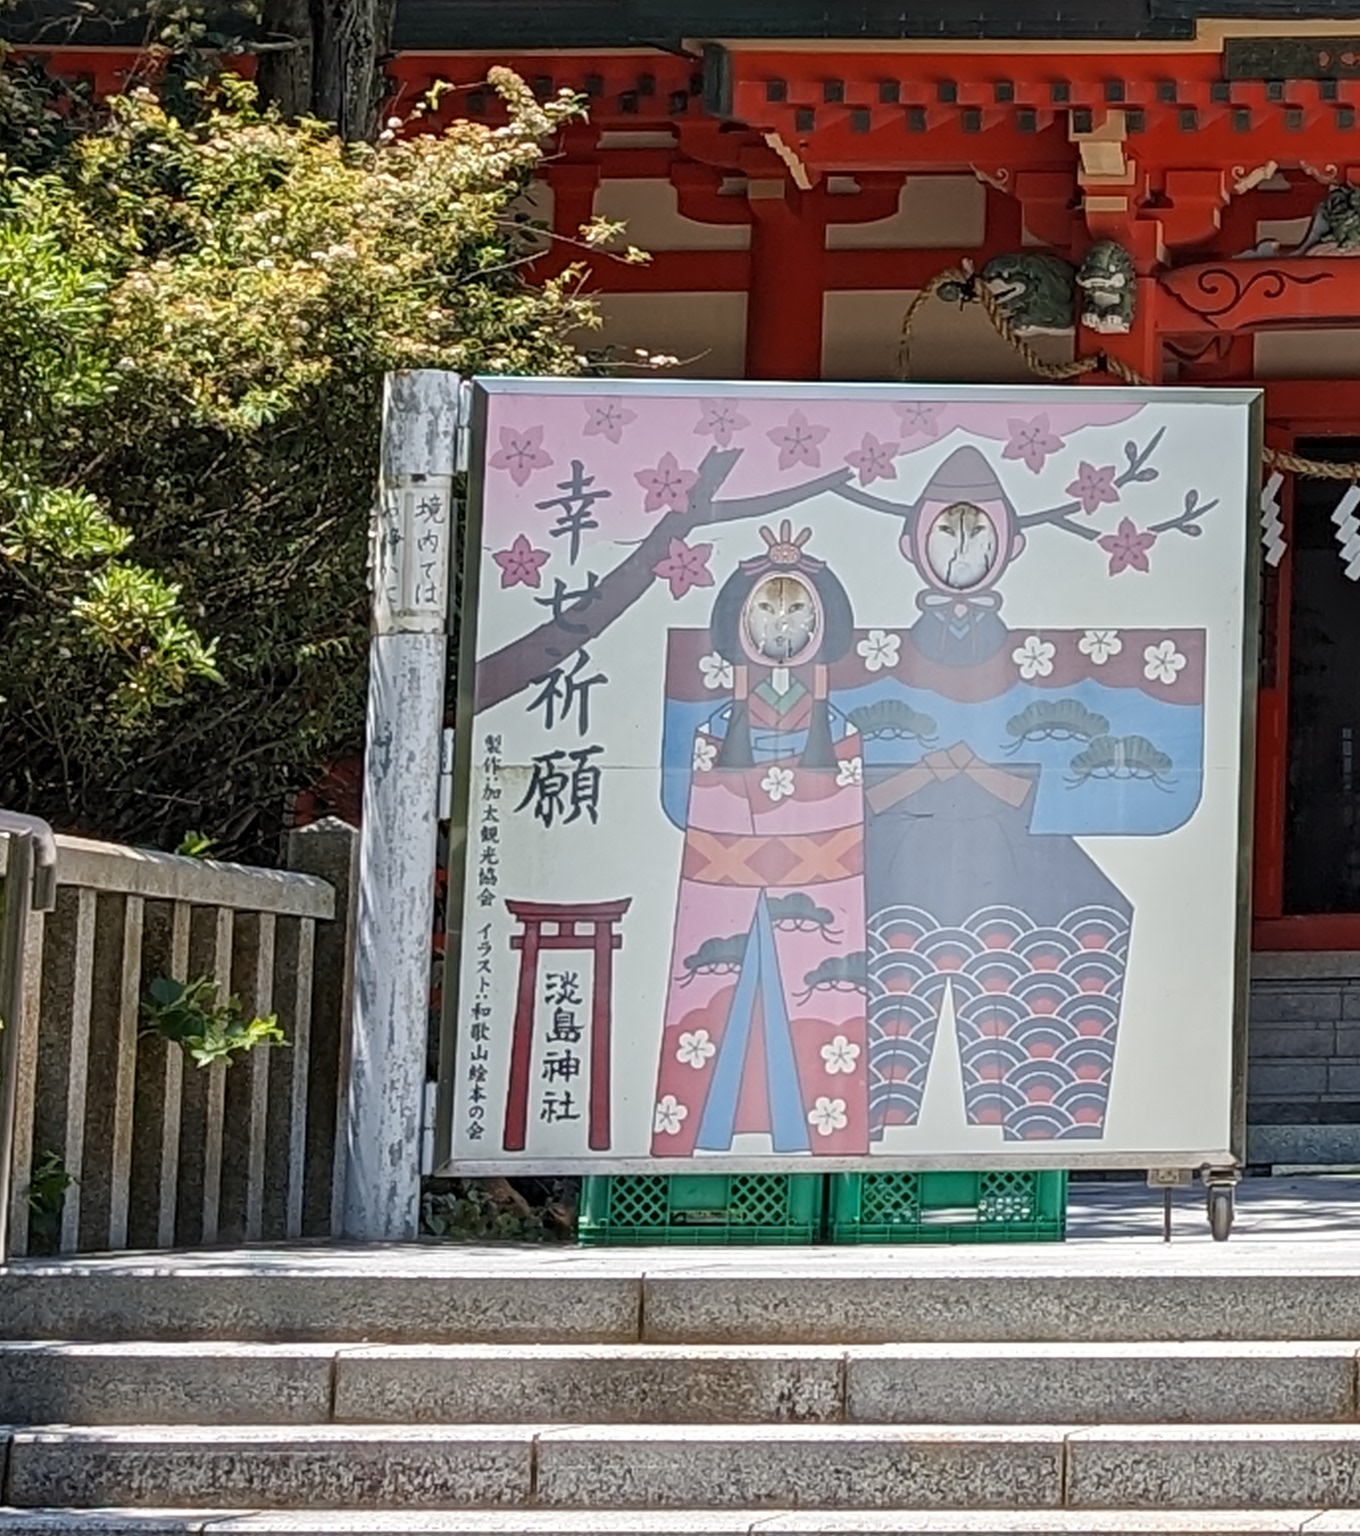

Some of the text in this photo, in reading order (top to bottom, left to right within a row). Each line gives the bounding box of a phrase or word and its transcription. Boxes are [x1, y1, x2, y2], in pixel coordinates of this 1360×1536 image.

[512, 459, 613, 829] 幸せ祈願
[539, 970, 585, 1124] 淡島神社
